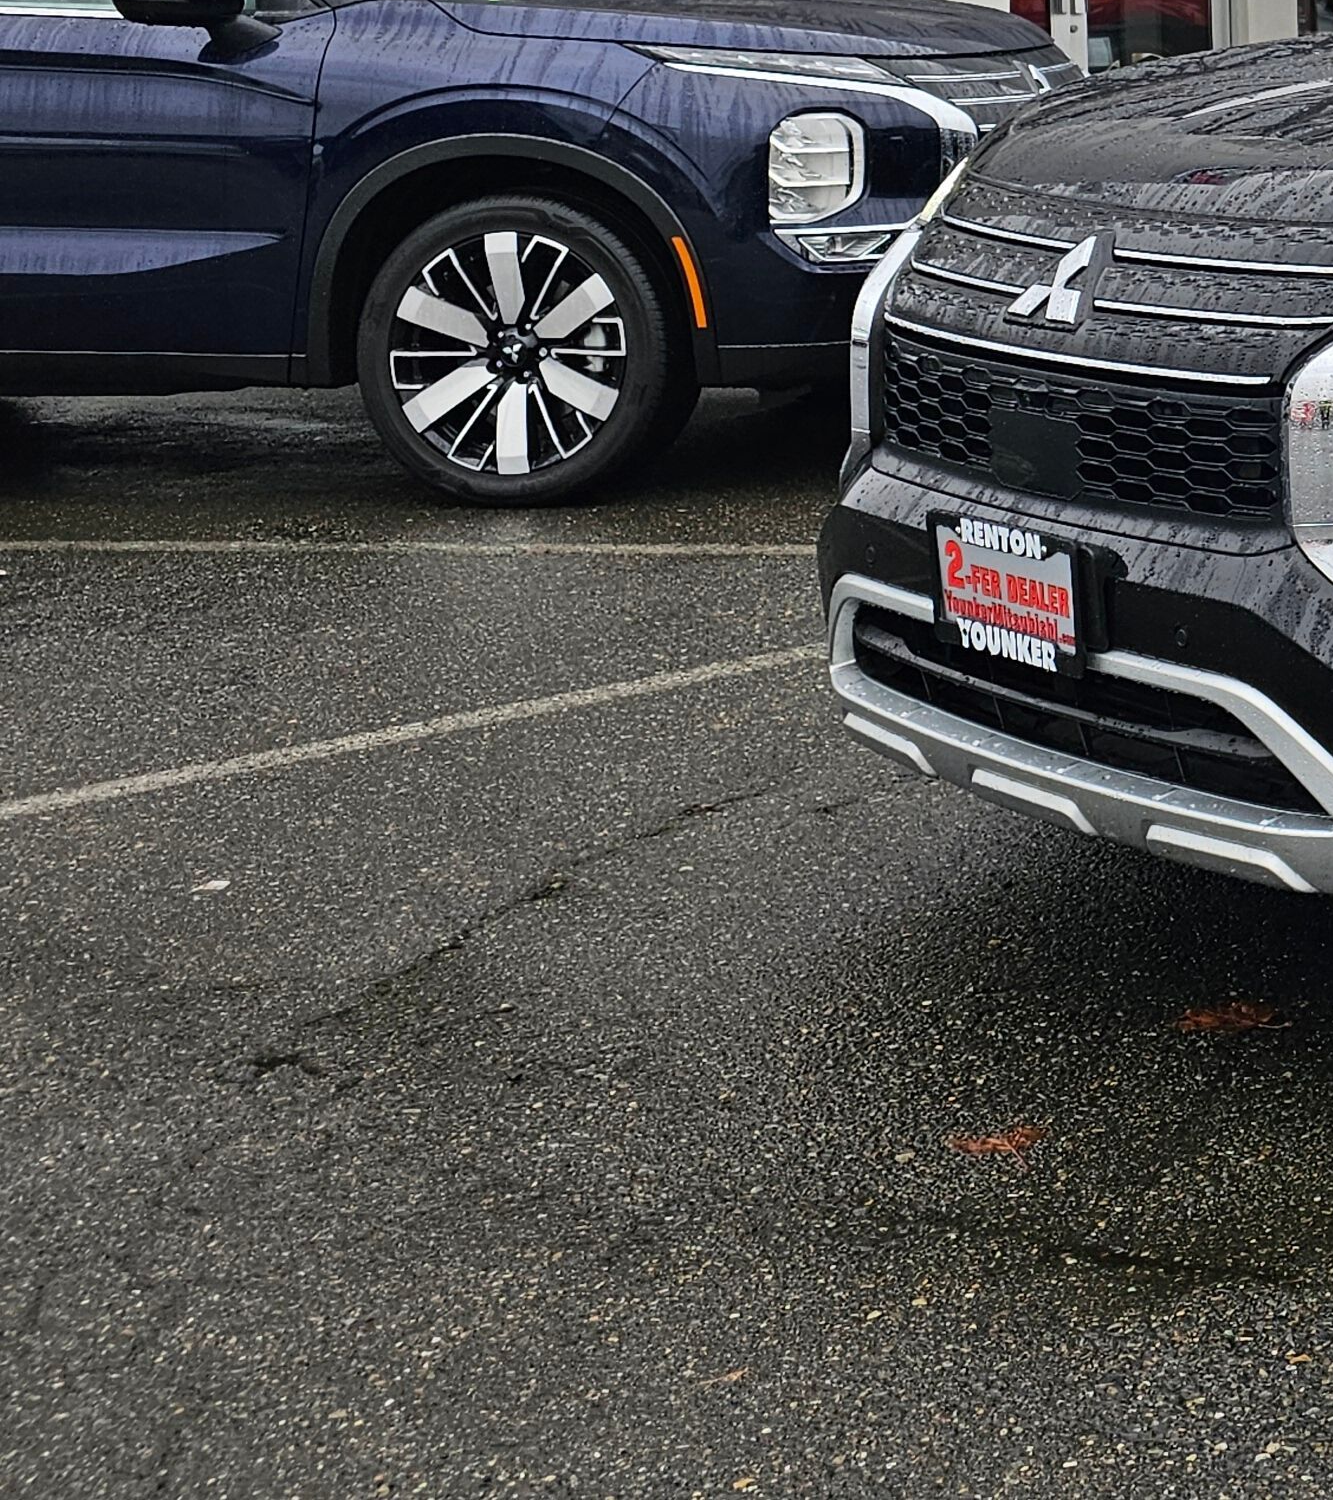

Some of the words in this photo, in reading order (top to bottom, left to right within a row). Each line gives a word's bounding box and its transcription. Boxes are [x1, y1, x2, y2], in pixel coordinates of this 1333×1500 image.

[960, 518, 1041, 560] RENTON
[944, 540, 1001, 600] 2-FER
[1006, 573, 1070, 618] DEALER
[956, 617, 1058, 672] YOUNKER
